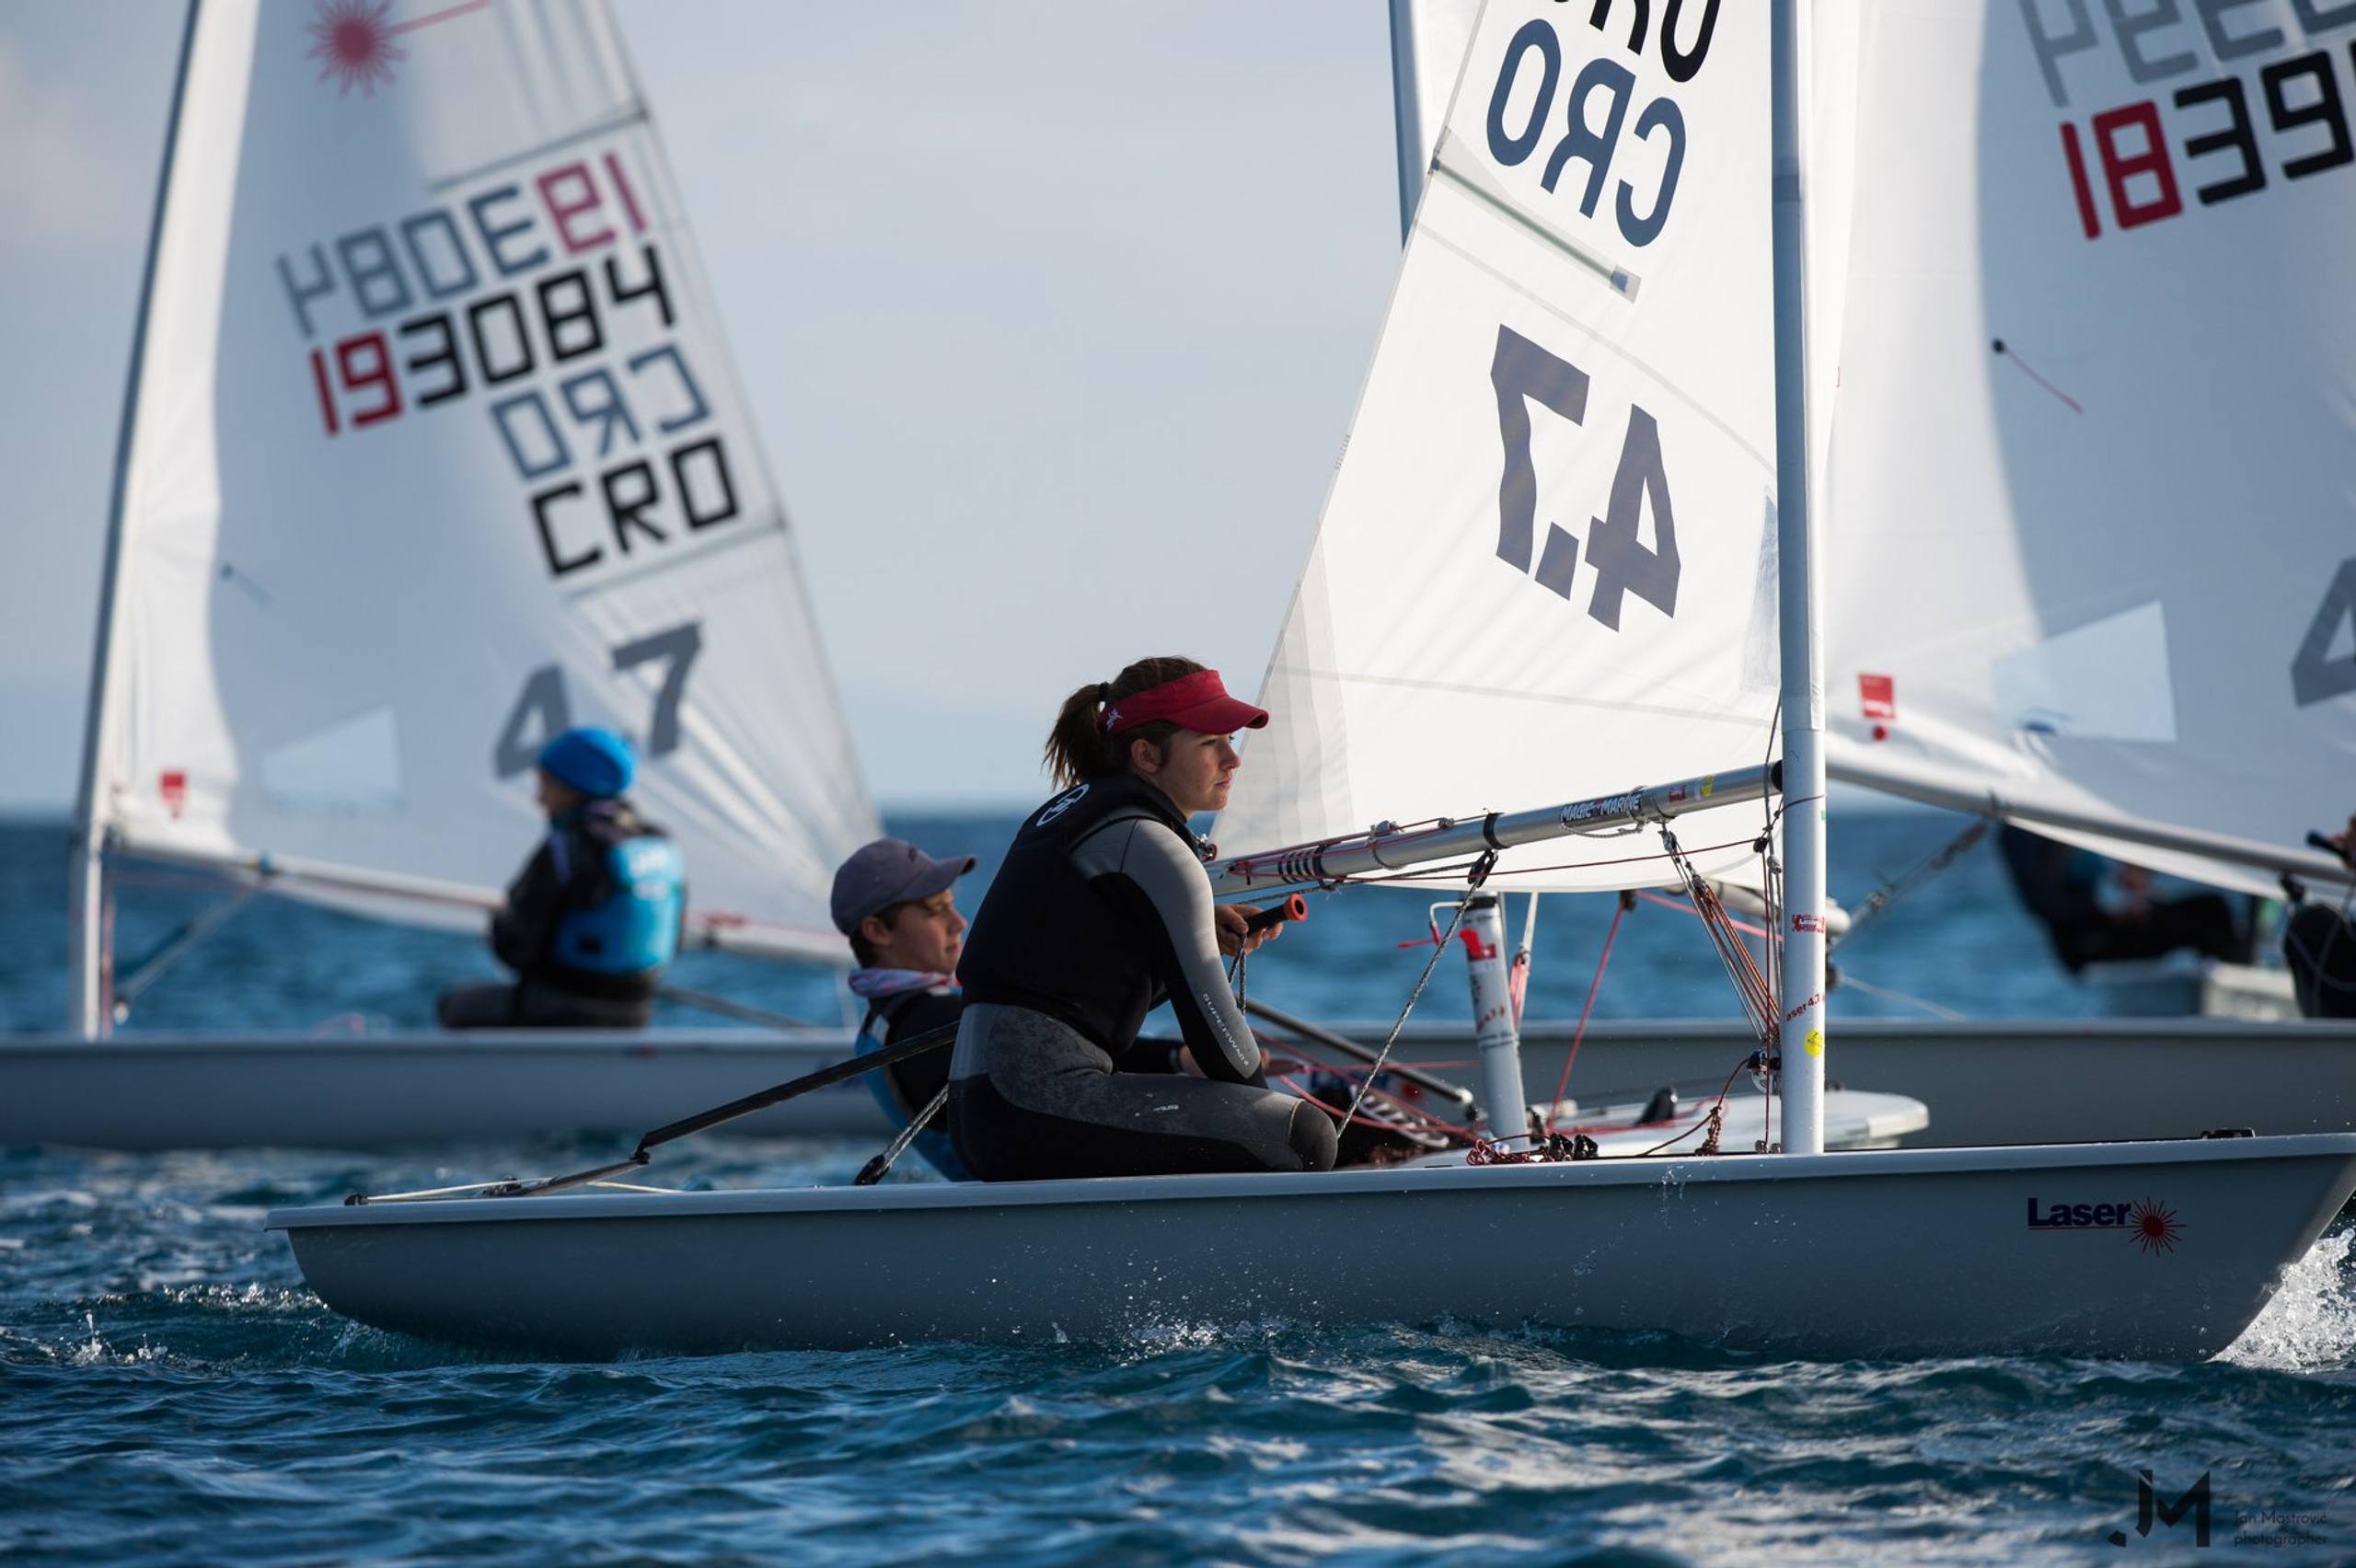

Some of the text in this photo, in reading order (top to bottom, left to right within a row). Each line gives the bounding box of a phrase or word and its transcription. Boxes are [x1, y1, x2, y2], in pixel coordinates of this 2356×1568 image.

[2060, 39, 2356, 241] 1839
[309, 246, 676, 436] 193084
[529, 437, 740, 578] CRO
[1560, 793, 1642, 821] MAGIC MARINE
[2027, 1198, 2131, 1227] Laser
